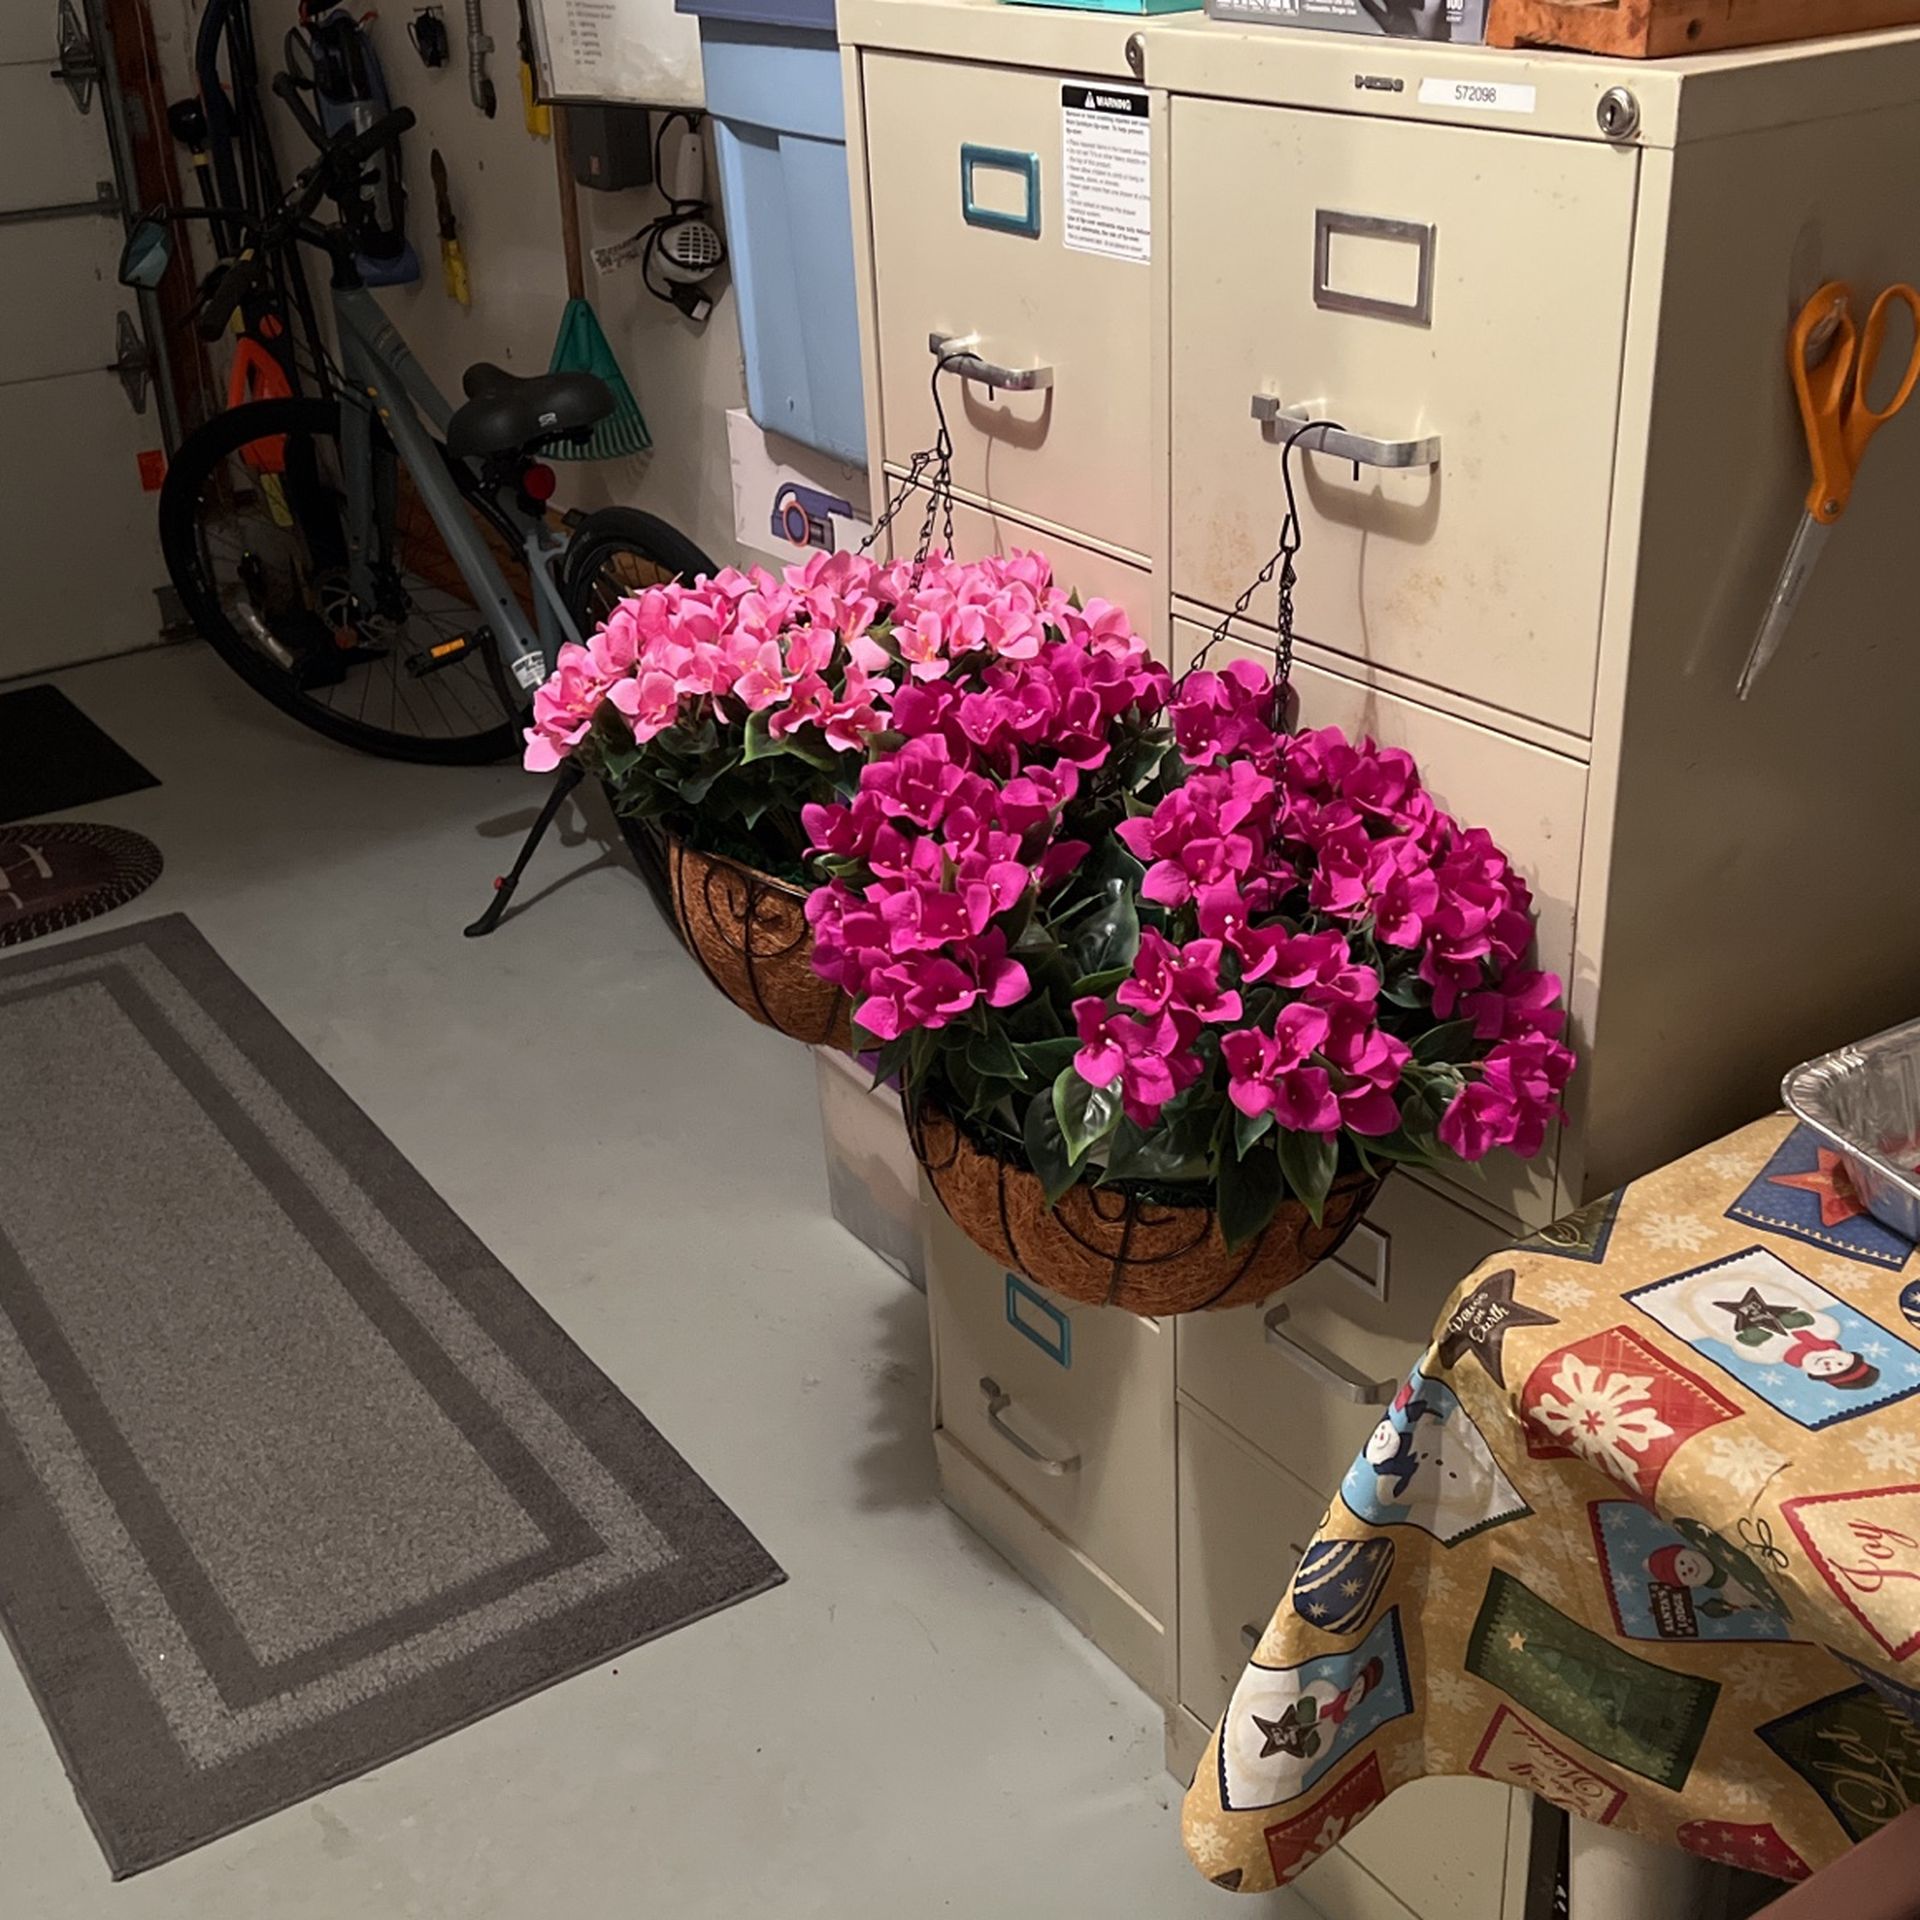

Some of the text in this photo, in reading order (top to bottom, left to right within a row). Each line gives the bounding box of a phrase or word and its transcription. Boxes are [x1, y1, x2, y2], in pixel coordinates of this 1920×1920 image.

[1096, 95, 1132, 111] WARNING
[1455, 84, 1497, 103] 572098
[1468, 1302, 1511, 1343] Earth
[1826, 1518, 1920, 1593] Joy
